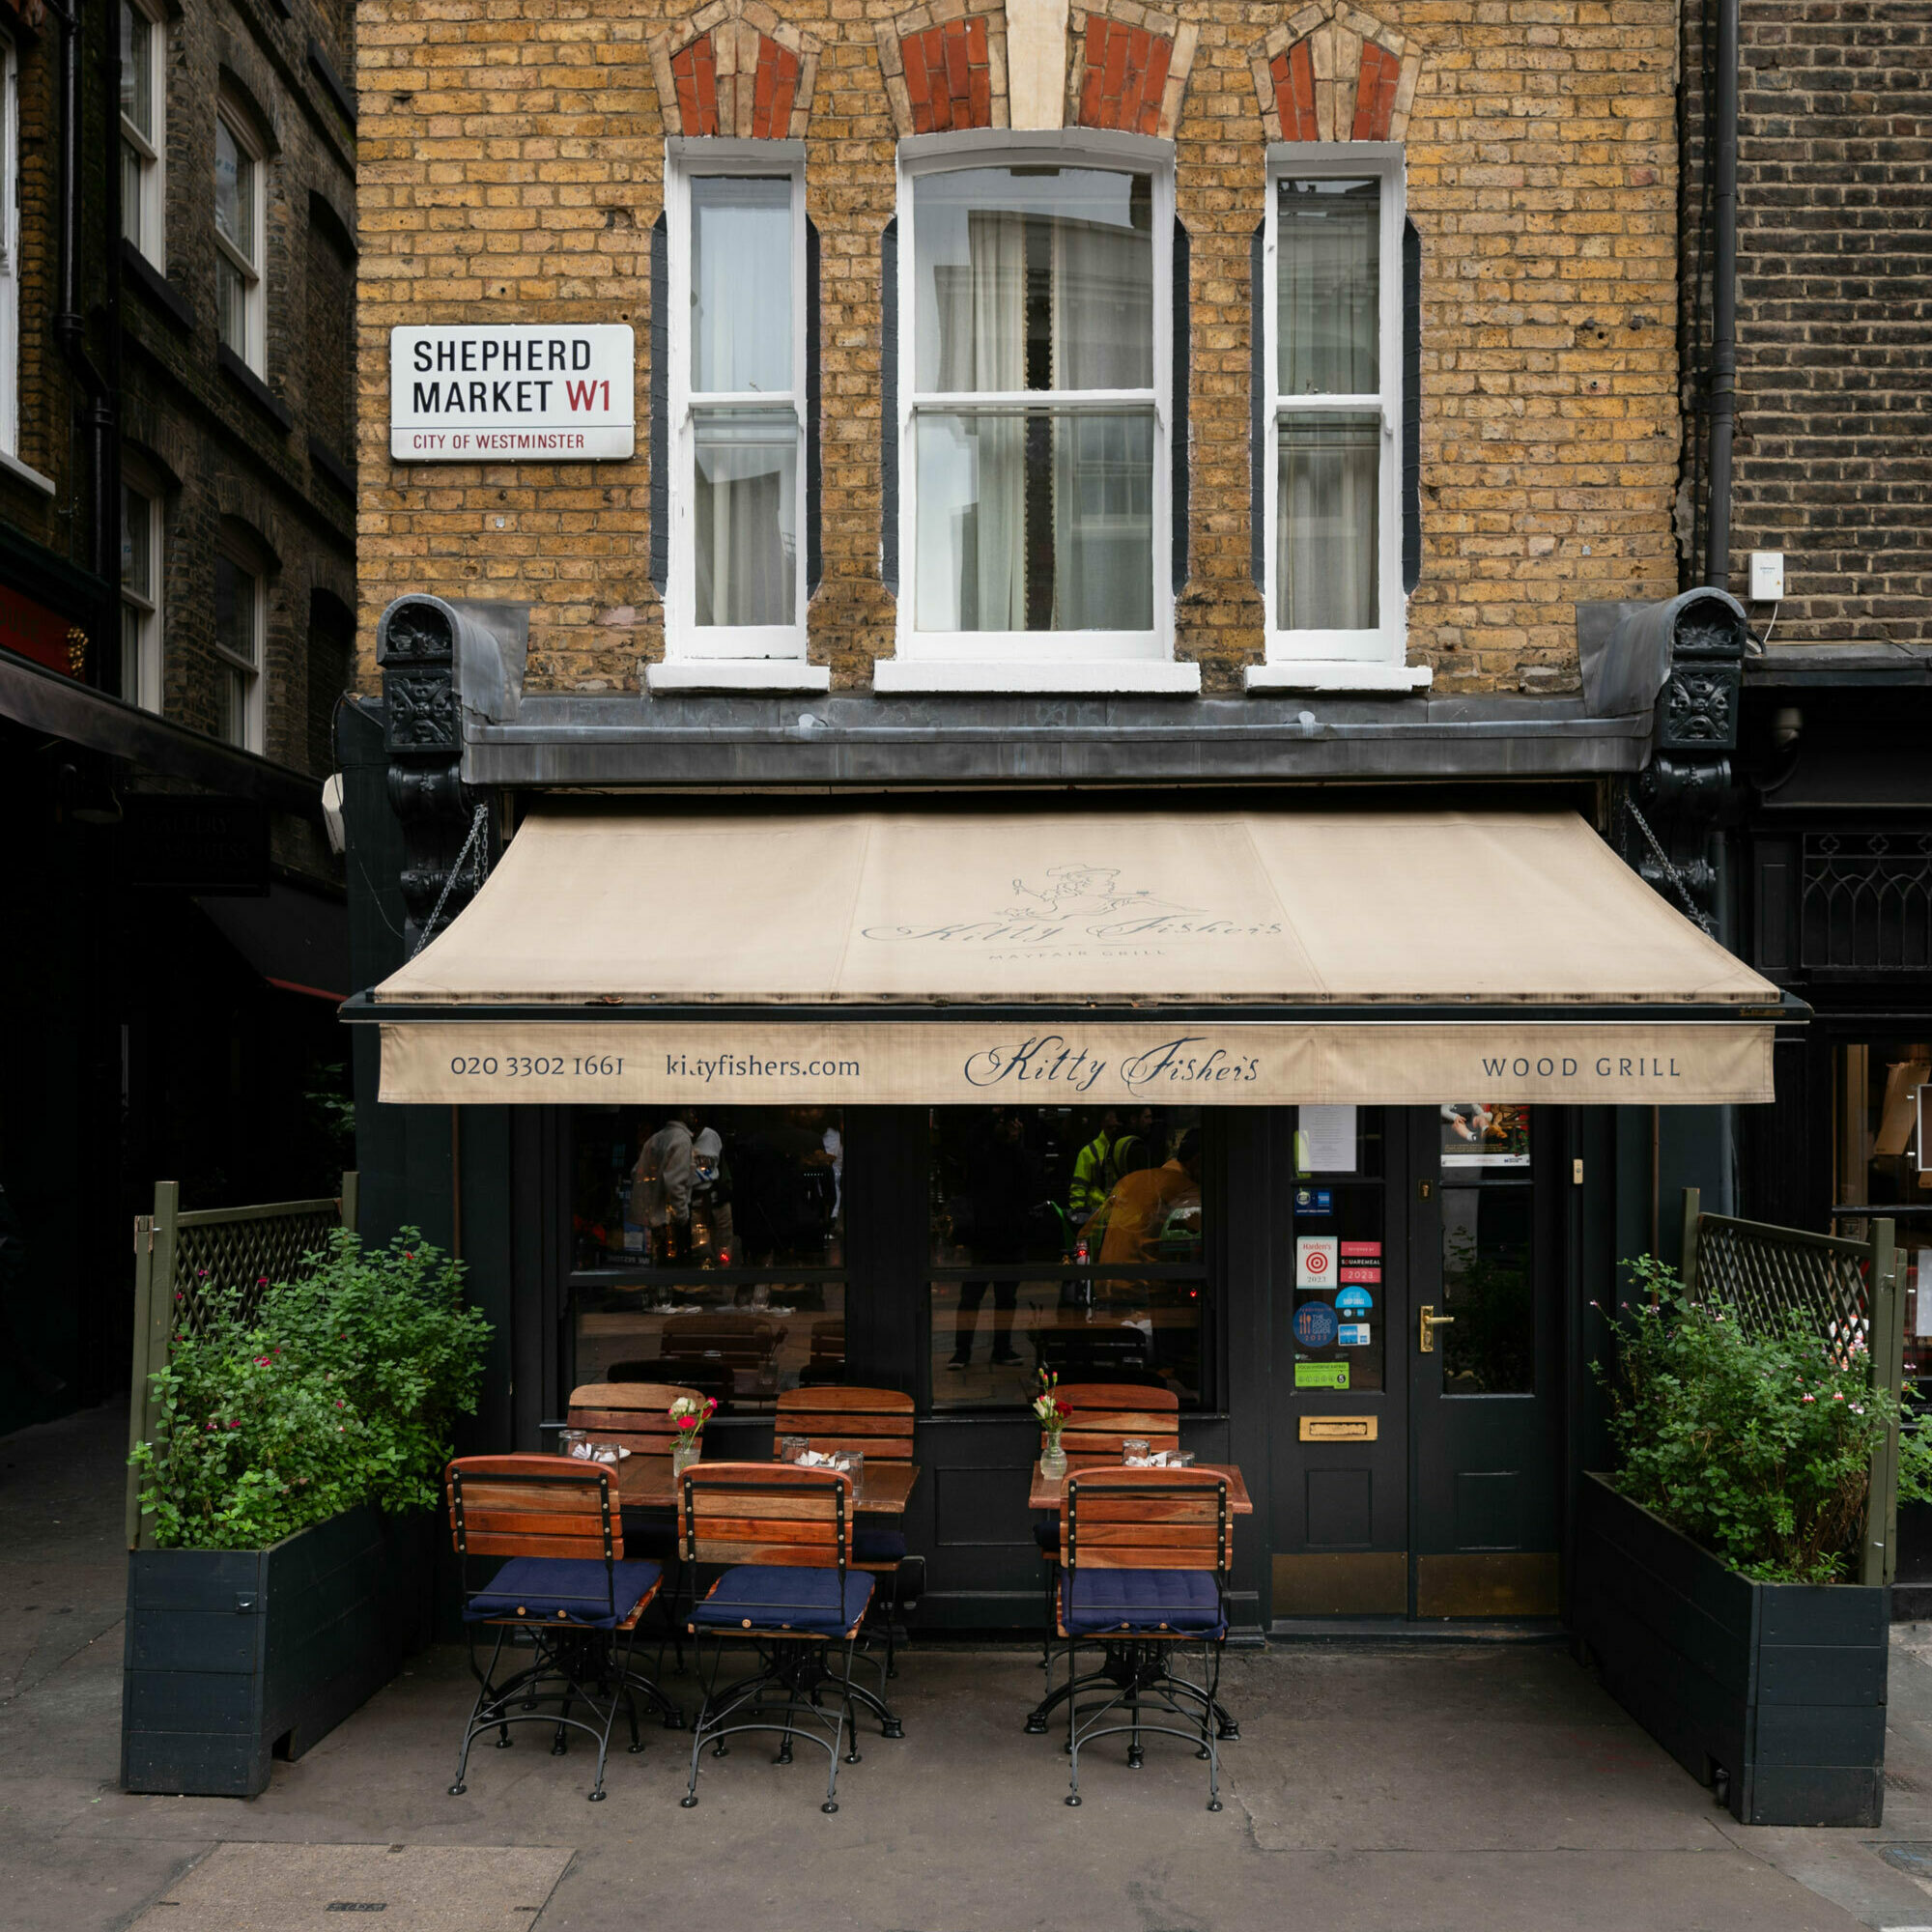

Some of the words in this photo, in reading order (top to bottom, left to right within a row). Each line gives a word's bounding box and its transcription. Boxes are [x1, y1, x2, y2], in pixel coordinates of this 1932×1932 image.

[413, 340, 591, 372] SHEPHERD
[412, 381, 554, 413] MARKET
[565, 380, 611, 412] W1
[412, 435, 446, 449] CITY
[452, 435, 470, 449] OF
[475, 434, 584, 449] WESTMINSTER
[861, 922, 1065, 943] Kitty
[988, 950, 1088, 960] MAYFAIR
[450, 1057, 498, 1075] 020
[505, 1057, 565, 1077] 3302
[573, 1055, 624, 1075] 1661
[666, 1054, 861, 1083] kityfishers.com
[965, 1036, 1106, 1092] Kitty
[1482, 1058, 1578, 1077] WOOD
[1596, 1058, 1681, 1077] GRILL
[1348, 1270, 1374, 1279] 2023
